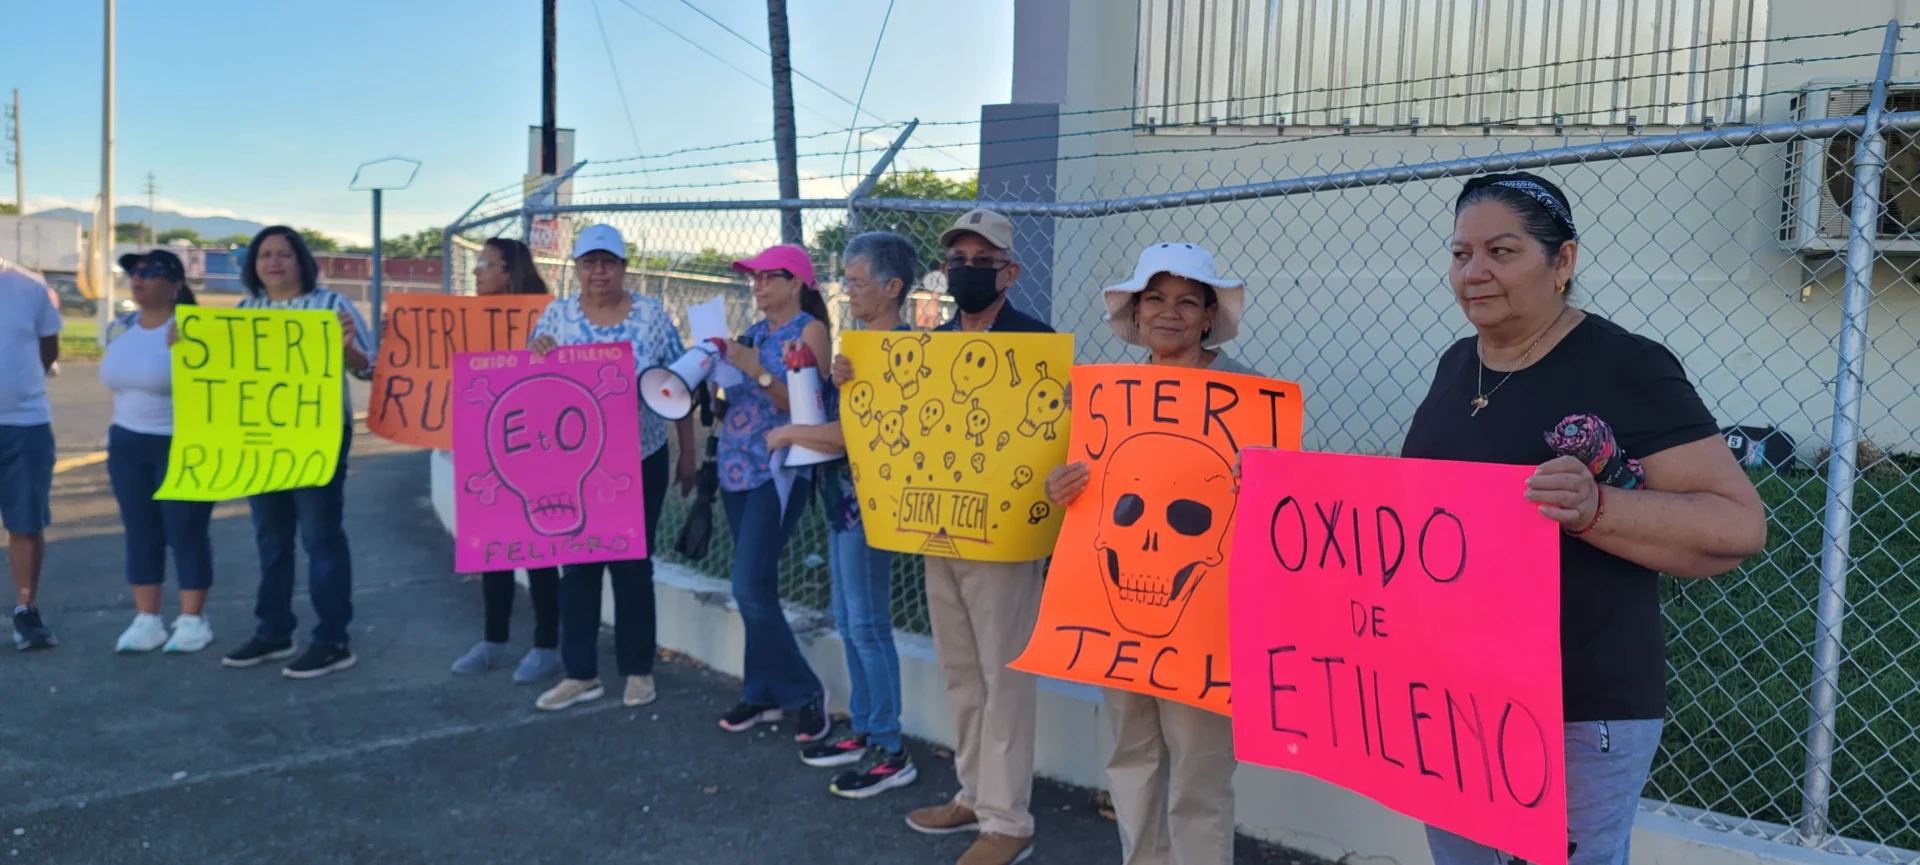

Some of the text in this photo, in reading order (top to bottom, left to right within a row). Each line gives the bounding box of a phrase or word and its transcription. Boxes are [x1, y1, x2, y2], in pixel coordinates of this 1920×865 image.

[182, 315, 333, 378] STERI
[389, 306, 469, 370] STERI
[192, 378, 323, 429] TECH
[380, 375, 450, 432] RU
[1085, 379, 1286, 460] STERI
[175, 444, 327, 494] RUIDO
[903, 493, 986, 530] STERI TECH
[484, 536, 629, 564] PELIGRO
[1270, 495, 1467, 586] OXIDO
[1350, 600, 1388, 637] DE
[1267, 645, 1553, 808] ETILENO
